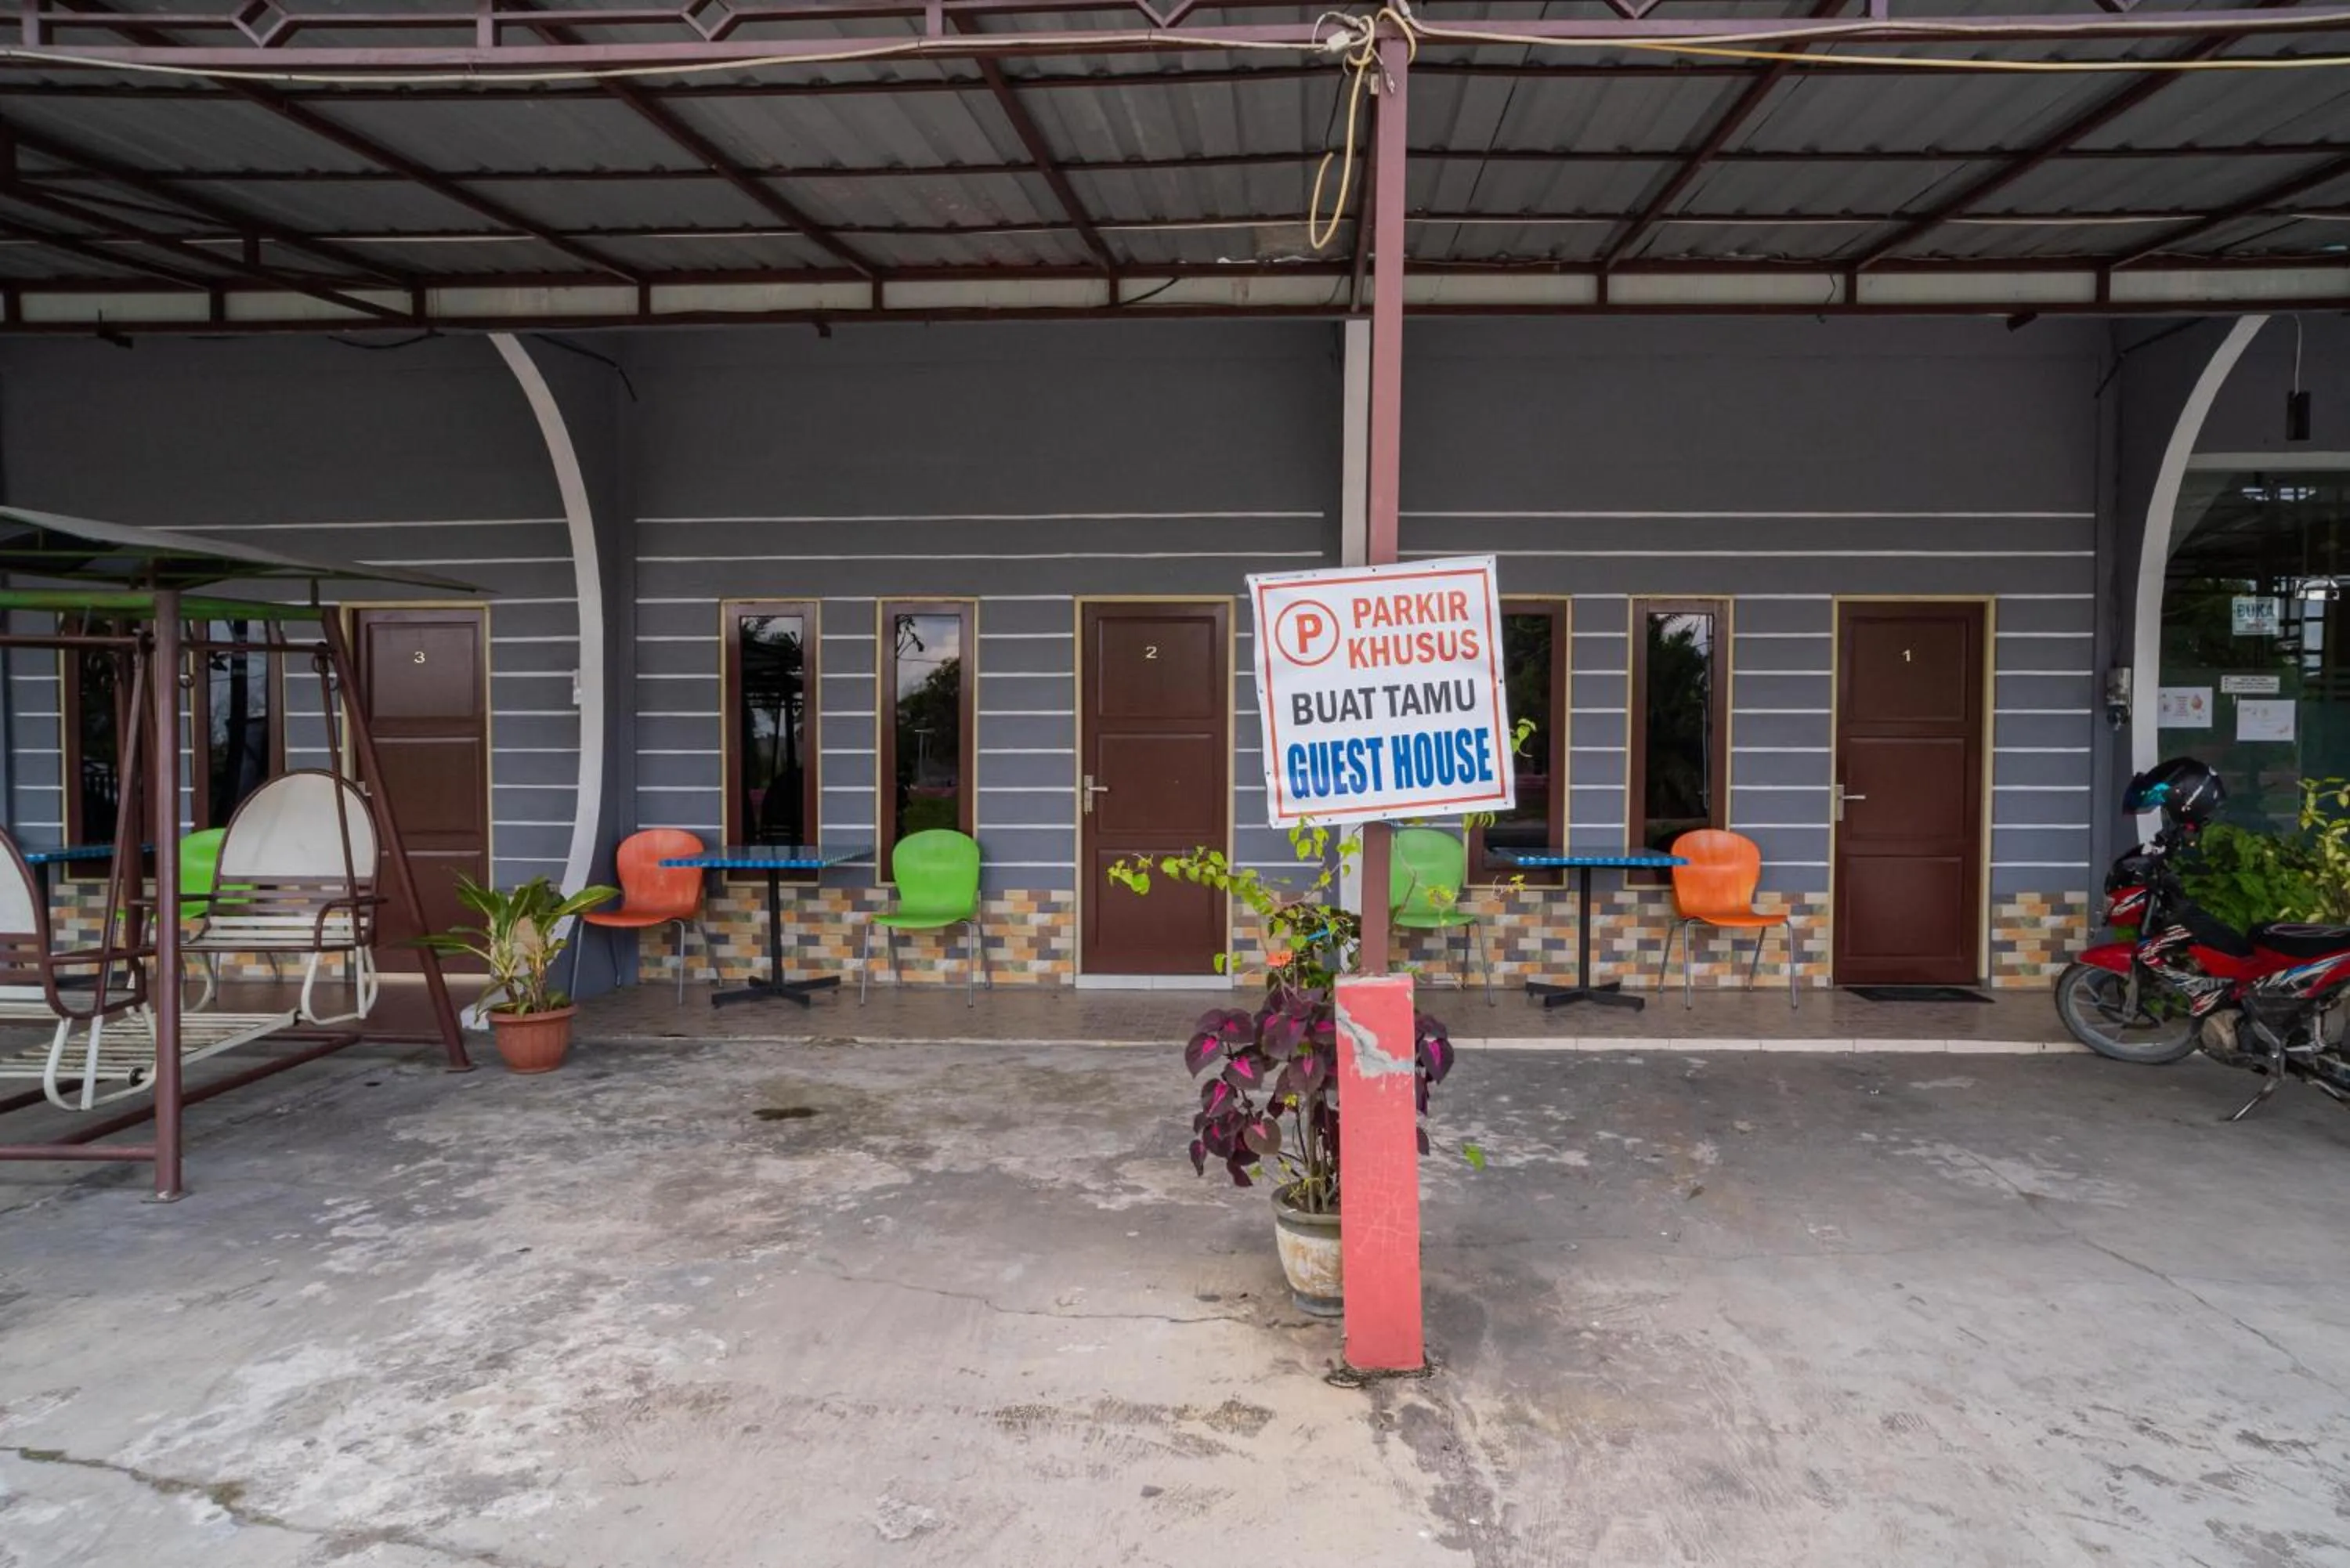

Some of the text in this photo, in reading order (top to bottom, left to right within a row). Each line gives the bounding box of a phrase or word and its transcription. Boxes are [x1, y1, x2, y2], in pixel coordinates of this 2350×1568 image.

[1351, 590, 1469, 629] PARKIR
[1146, 646, 1158, 659] 2
[1296, 613, 1323, 654] P
[1347, 629, 1480, 670] KHUSUS
[414, 651, 425, 663] 3
[1903, 649, 1911, 662] 1
[1292, 678, 1477, 726] BUAT TAMU
[1287, 727, 1494, 800] GUEST HOUSE
